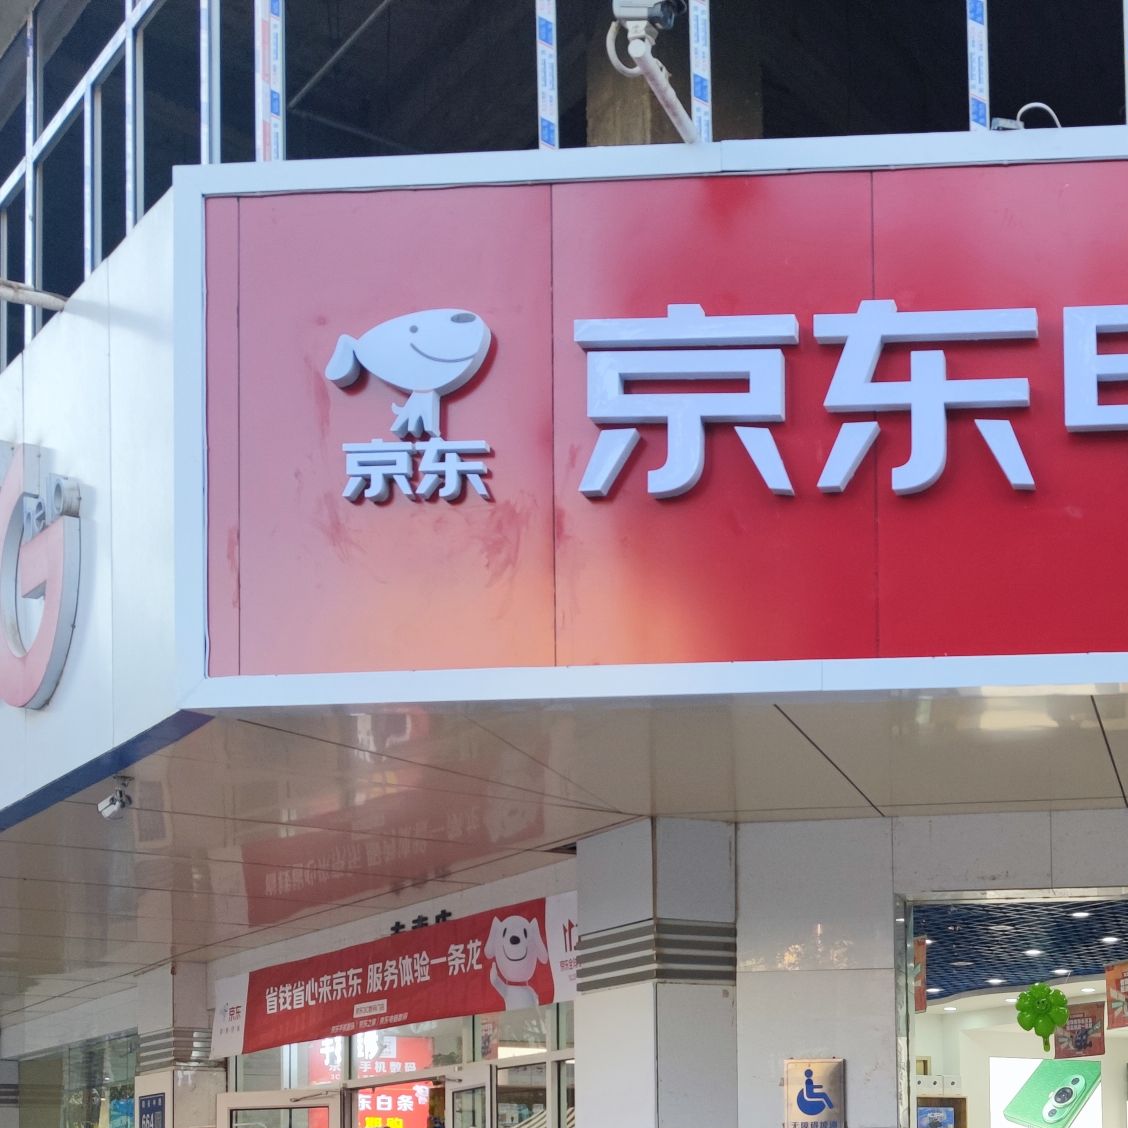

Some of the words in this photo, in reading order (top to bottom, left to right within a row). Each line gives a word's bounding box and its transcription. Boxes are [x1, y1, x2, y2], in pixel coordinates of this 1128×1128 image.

[341, 438, 491, 503] 京东
[265, 966, 363, 1014] 省钱省心来京东
[366, 939, 483, 993] 服务体验一条龙
